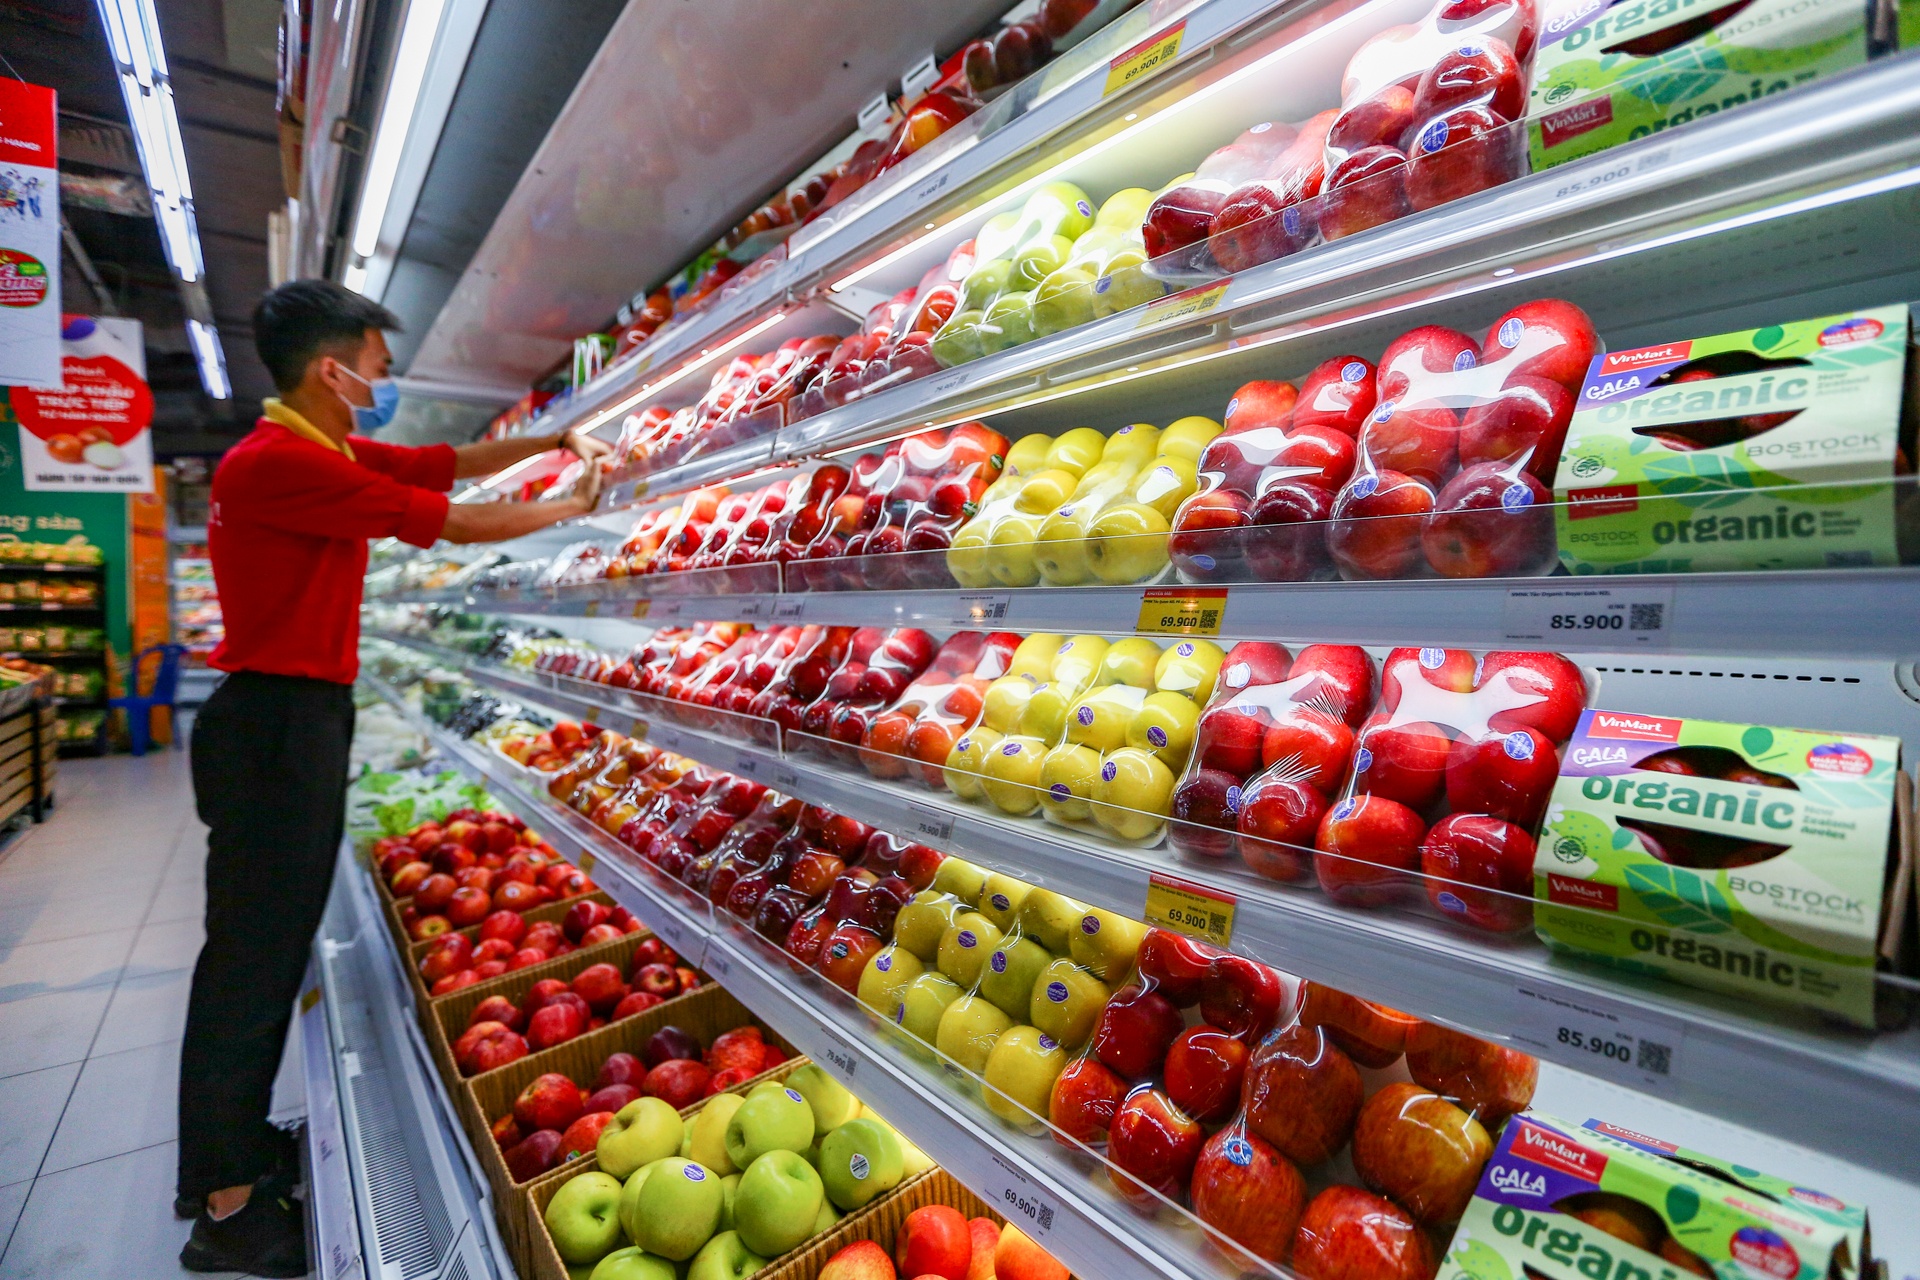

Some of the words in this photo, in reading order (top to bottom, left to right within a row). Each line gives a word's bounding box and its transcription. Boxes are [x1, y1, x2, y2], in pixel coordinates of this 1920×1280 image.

[1125, 56, 1159, 79] 69.900
[1544, 106, 1597, 133] VinMart
[1556, 166, 1630, 198] 85.900
[1609, 348, 1673, 366] VinMart
[1586, 376, 1641, 400] GALA
[1597, 376, 1808, 424] organic
[1746, 433, 1881, 457] BOSTOCK
[1570, 531, 1638, 543] BOSTOCK
[1652, 506, 1816, 545] organic
[1161, 616, 1197, 627] 69.900
[1551, 614, 1623, 630] 85.900
[1599, 715, 1662, 732] VinMart
[1573, 746, 1628, 765] GALA
[1582, 775, 1794, 830] organic
[1552, 878, 1604, 900] VinMart
[1728, 876, 1863, 914] BOSTOCK
[1169, 909, 1206, 930] 69.900
[1630, 929, 1794, 987] organic
[1557, 1026, 1631, 1063] 85.900
[1605, 1123, 1662, 1145] VinMart
[1524, 1127, 1588, 1166] VinMart
[1489, 1165, 1547, 1196] GALA
[1005, 1188, 1036, 1219] 69.900
